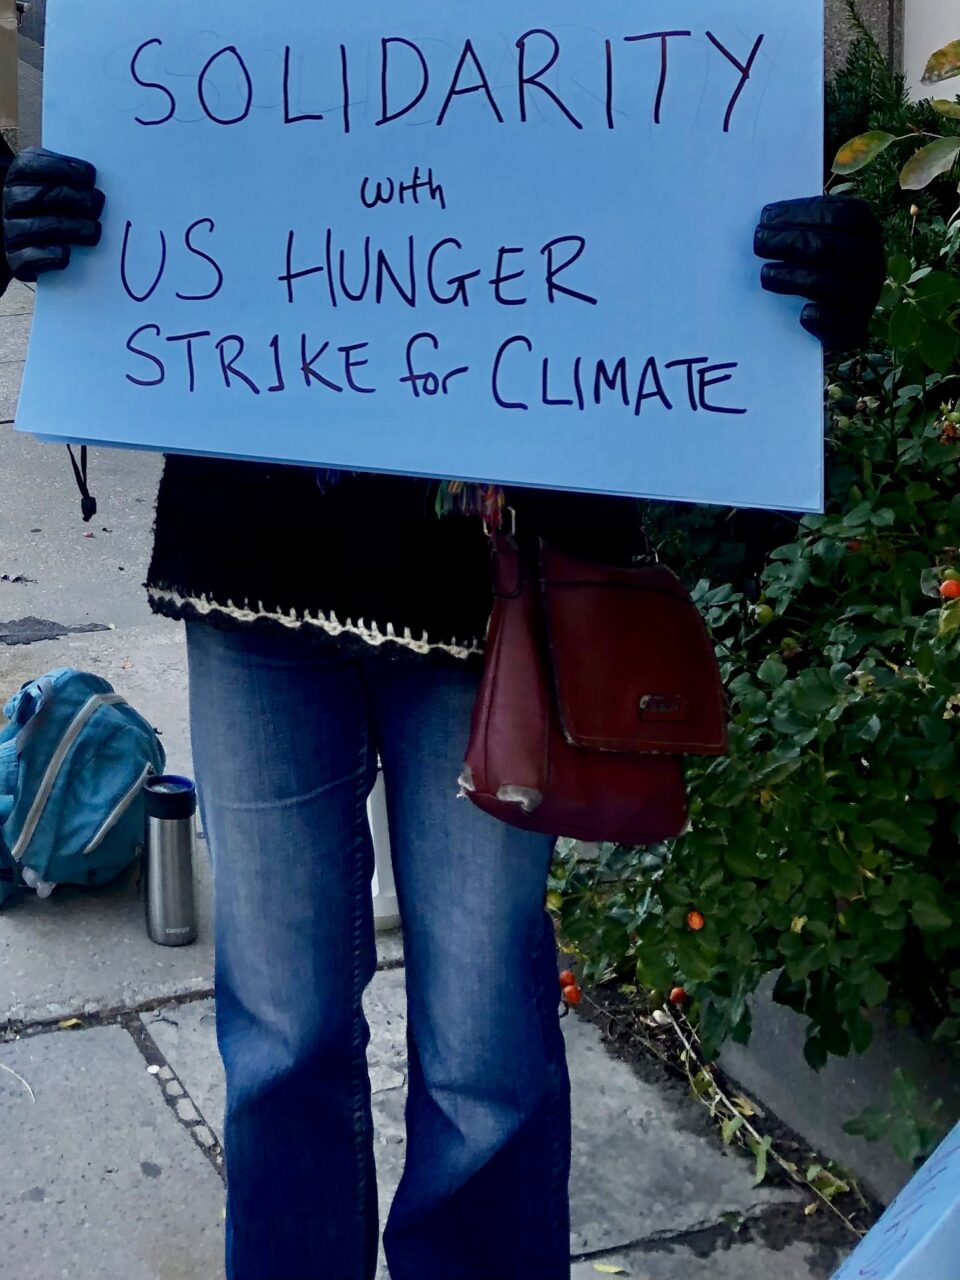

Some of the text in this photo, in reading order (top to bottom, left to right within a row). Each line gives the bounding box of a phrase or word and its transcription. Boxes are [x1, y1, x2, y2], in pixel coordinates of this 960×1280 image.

[130, 28, 765, 134] SOLIDARITY
[360, 166, 446, 210] with
[120, 217, 598, 308] US HUNGER
[125, 323, 748, 417] STRIKE for CLIMATE
